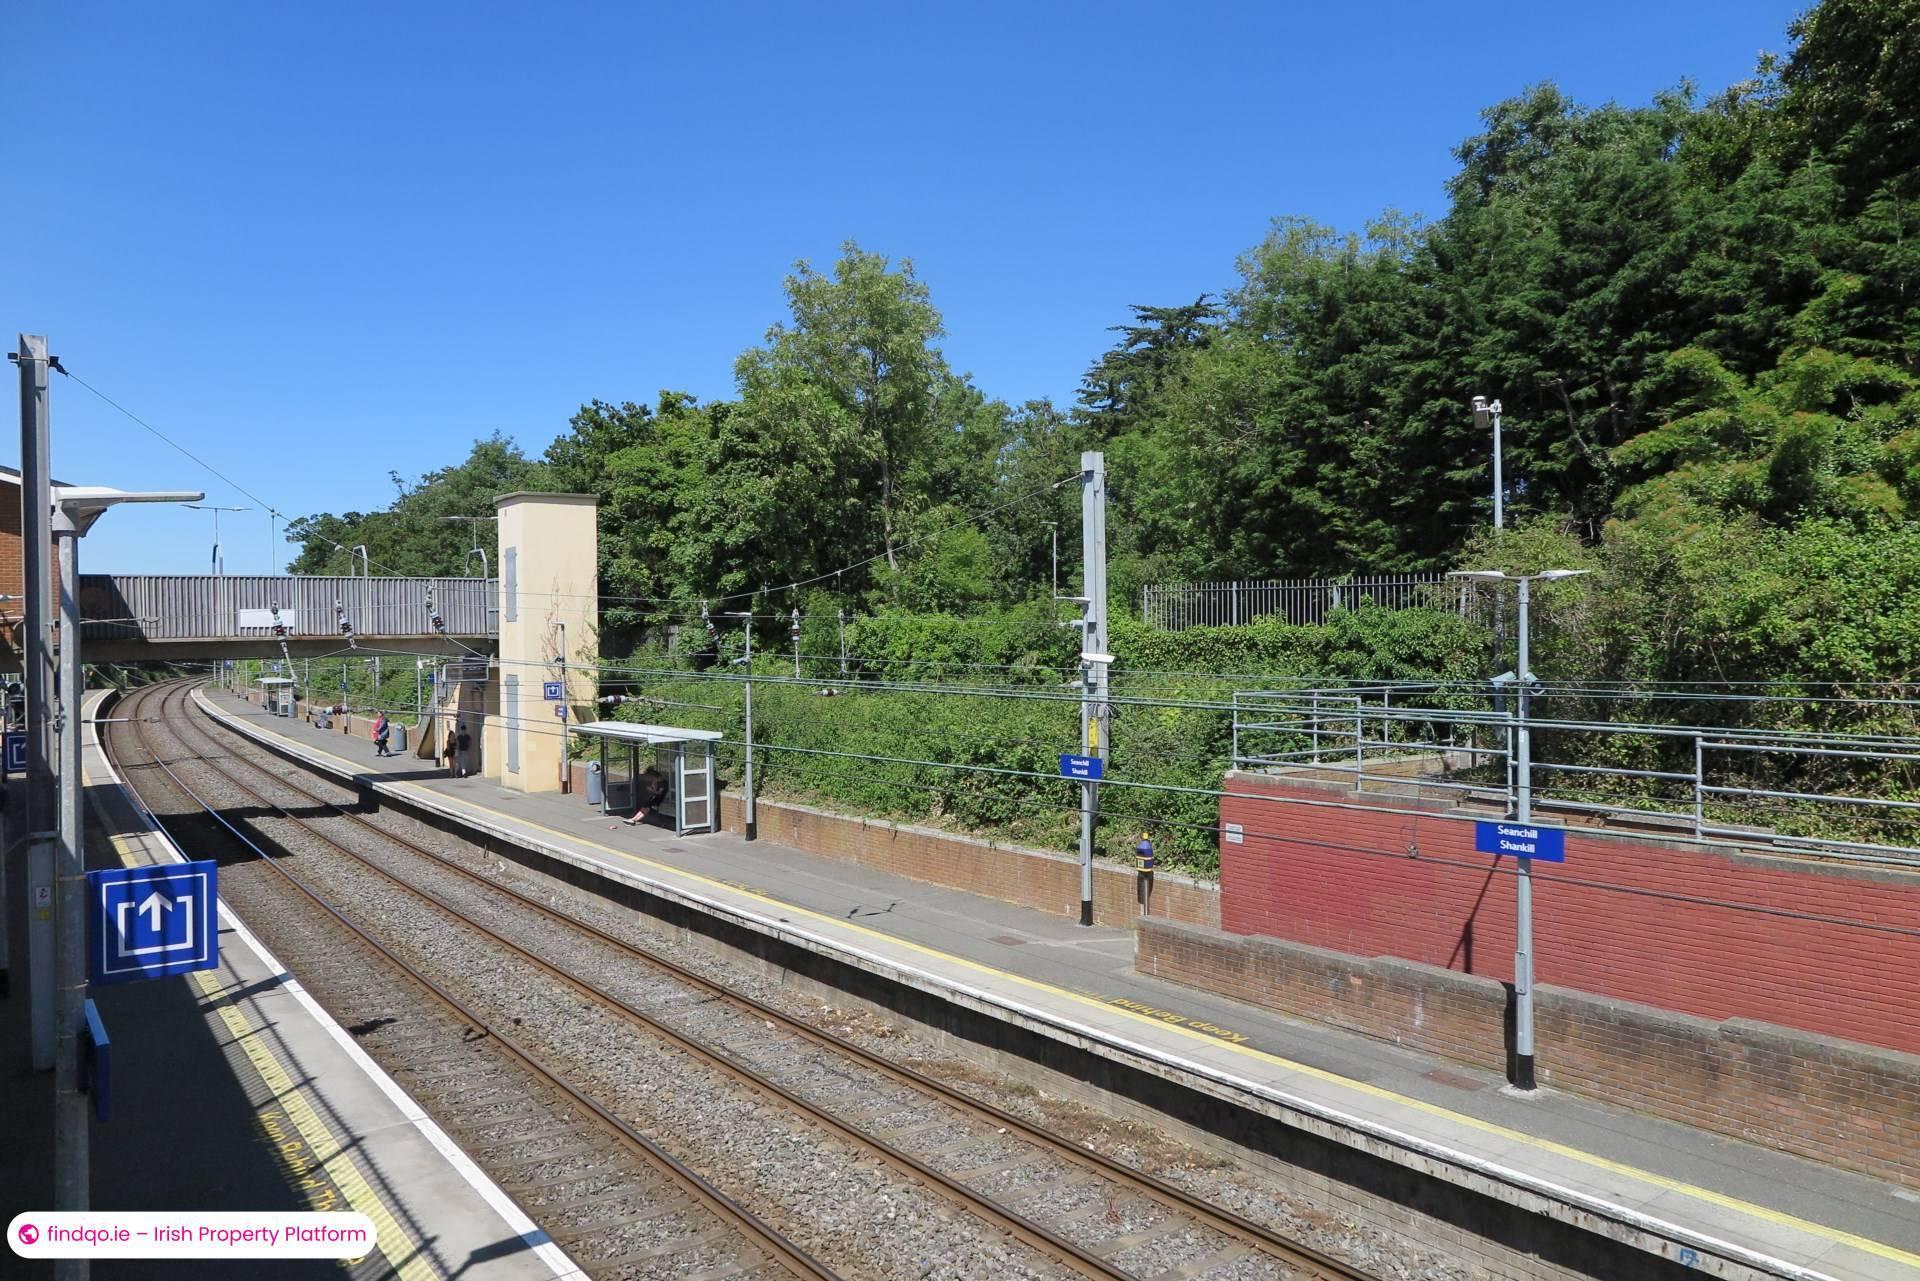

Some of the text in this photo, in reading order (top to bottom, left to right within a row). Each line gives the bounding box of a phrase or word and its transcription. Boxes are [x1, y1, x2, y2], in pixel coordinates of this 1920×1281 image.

[1498, 825, 1538, 839] Seanchill
[1500, 840, 1535, 853] Shankill
[1109, 998, 1249, 1042] Keep Behind
